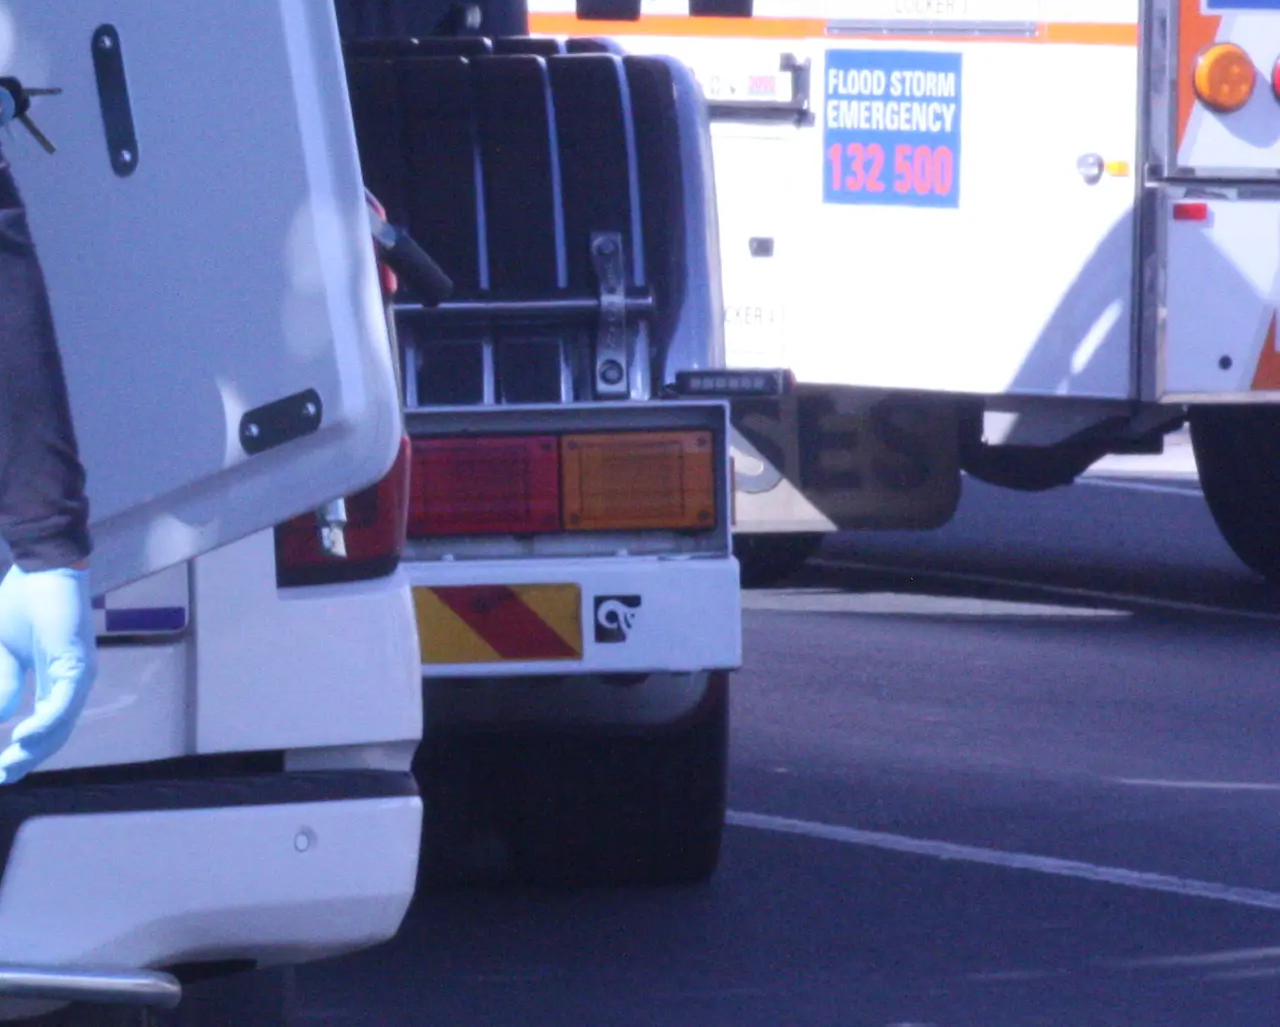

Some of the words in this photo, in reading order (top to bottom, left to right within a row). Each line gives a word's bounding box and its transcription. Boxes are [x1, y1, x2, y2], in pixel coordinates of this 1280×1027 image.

[827, 68, 886, 96] FLOOD
[890, 70, 955, 97] STORM
[826, 99, 956, 133] EMERGENCY
[828, 142, 886, 193] 132
[893, 144, 953, 196] 500
